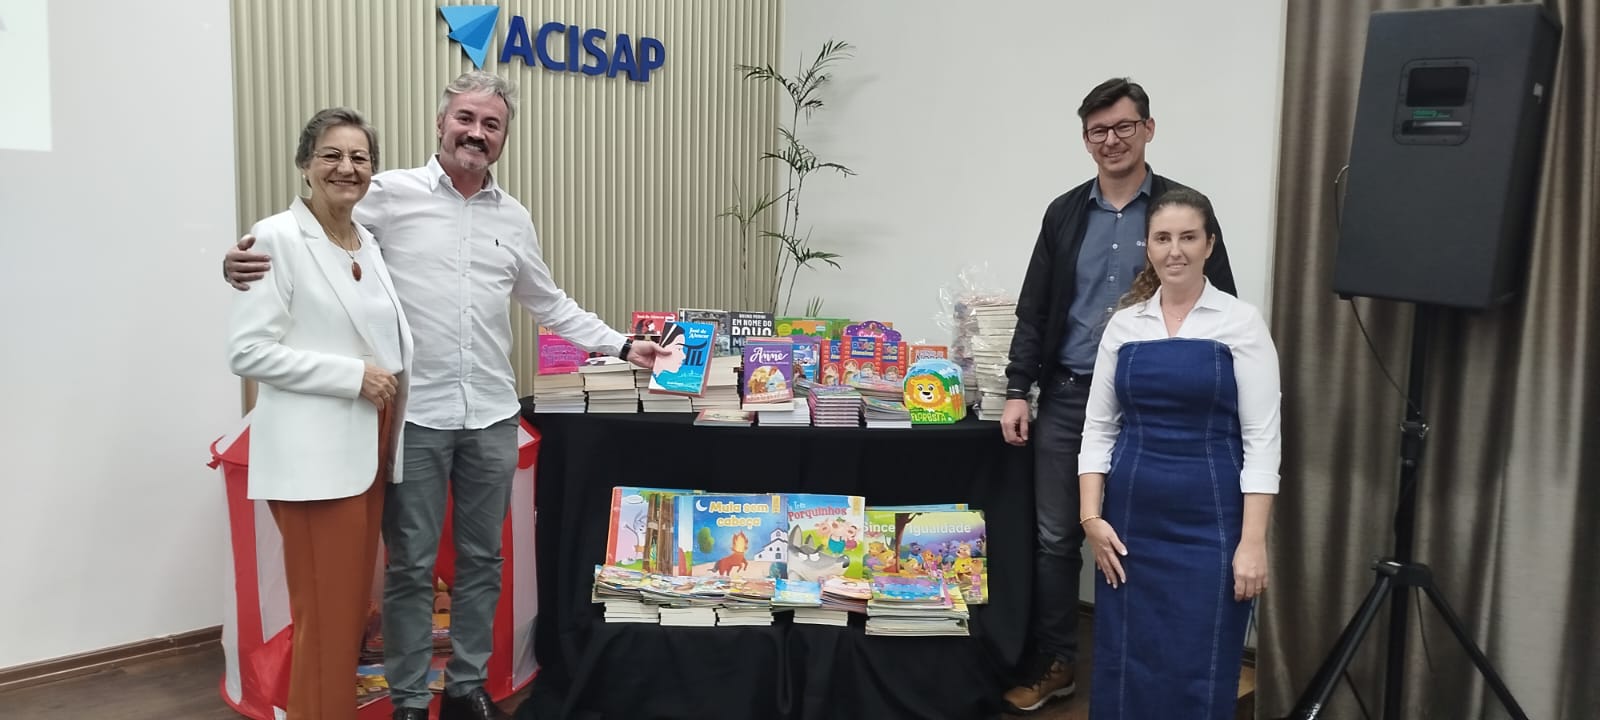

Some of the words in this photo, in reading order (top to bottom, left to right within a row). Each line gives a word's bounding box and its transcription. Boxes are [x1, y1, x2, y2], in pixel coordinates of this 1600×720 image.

[500, 15, 666, 82] ACISAP
[743, 319, 762, 327] NOME
[749, 347, 789, 364] Anne
[709, 501, 741, 513] Mula
[743, 503, 769, 513] sem
[788, 506, 847, 521] Porquinhos
[716, 515, 762, 530] cabeça
[910, 522, 972, 536] Igualdade
